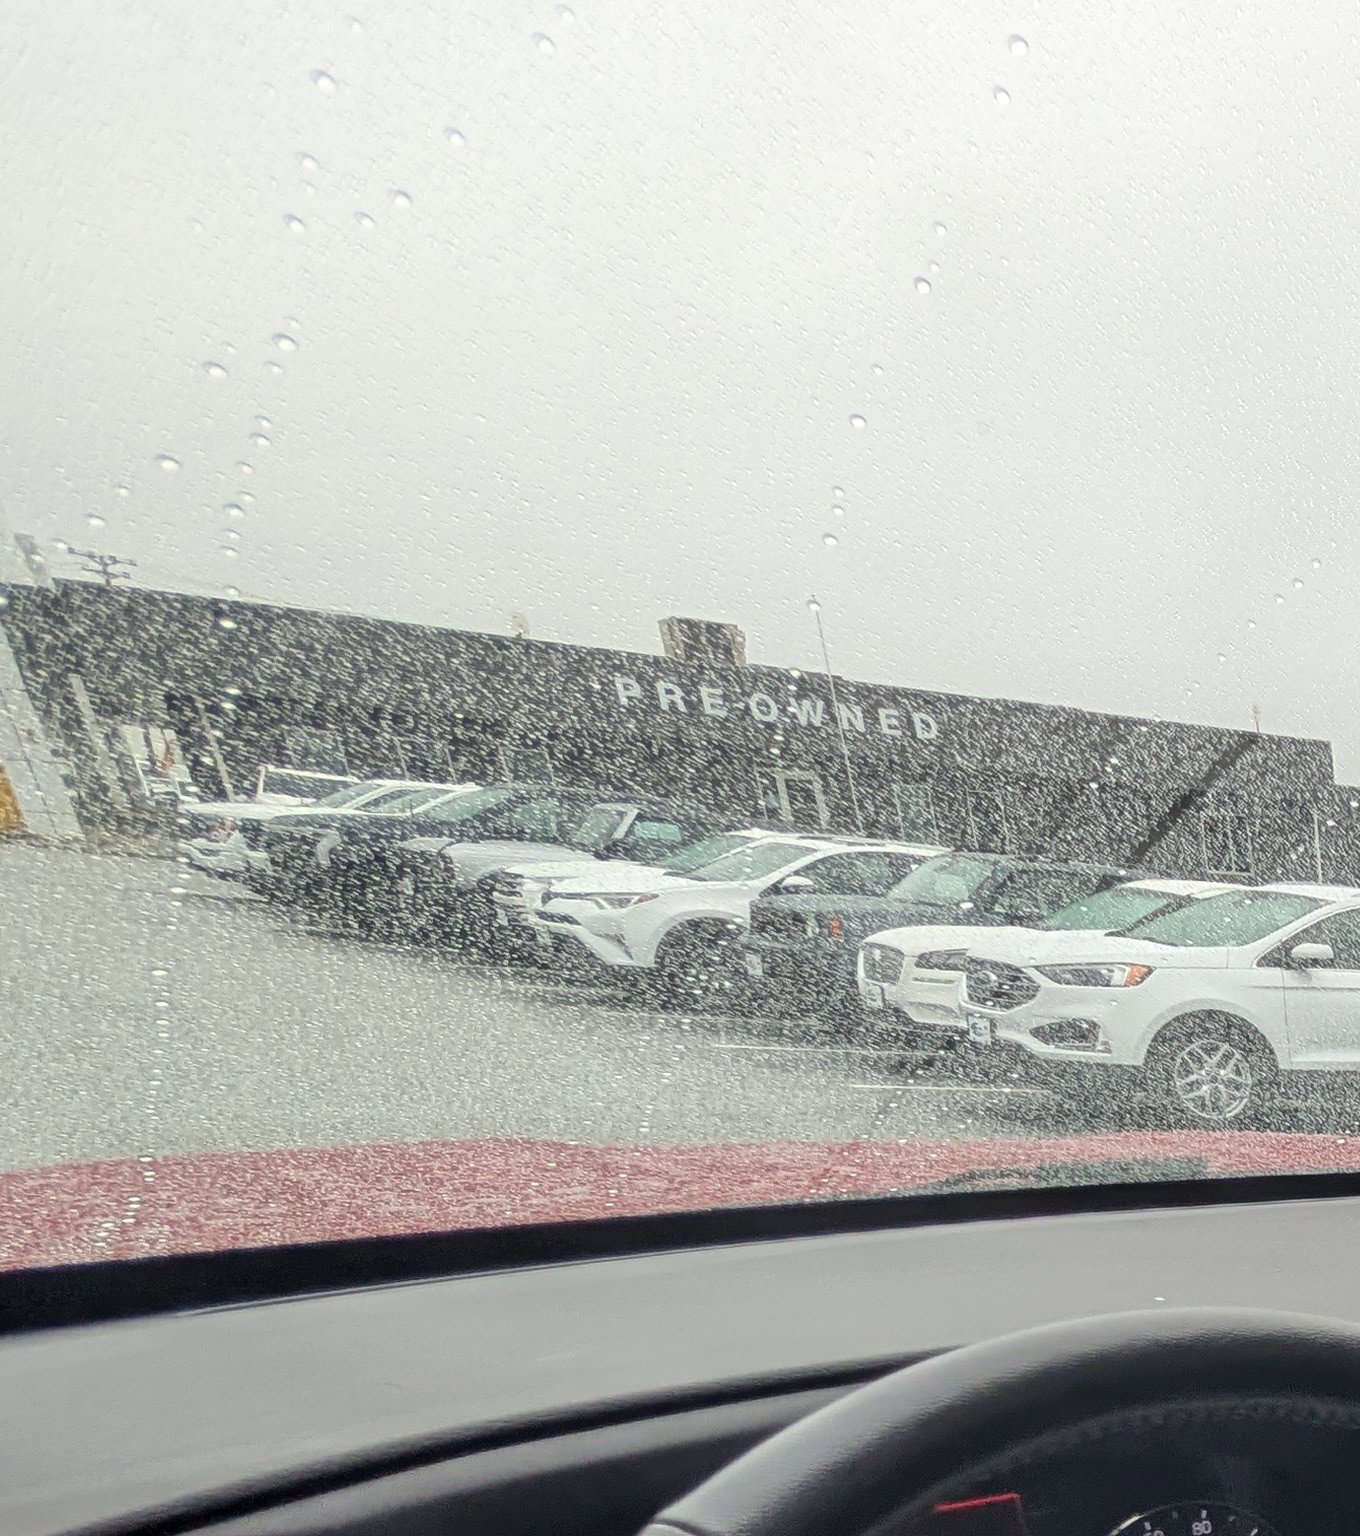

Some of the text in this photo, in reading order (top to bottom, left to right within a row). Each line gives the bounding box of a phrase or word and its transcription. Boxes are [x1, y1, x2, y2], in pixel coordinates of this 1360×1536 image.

[613, 676, 939, 740] PRE OWNED
[1192, 1520, 1212, 1536] 80
